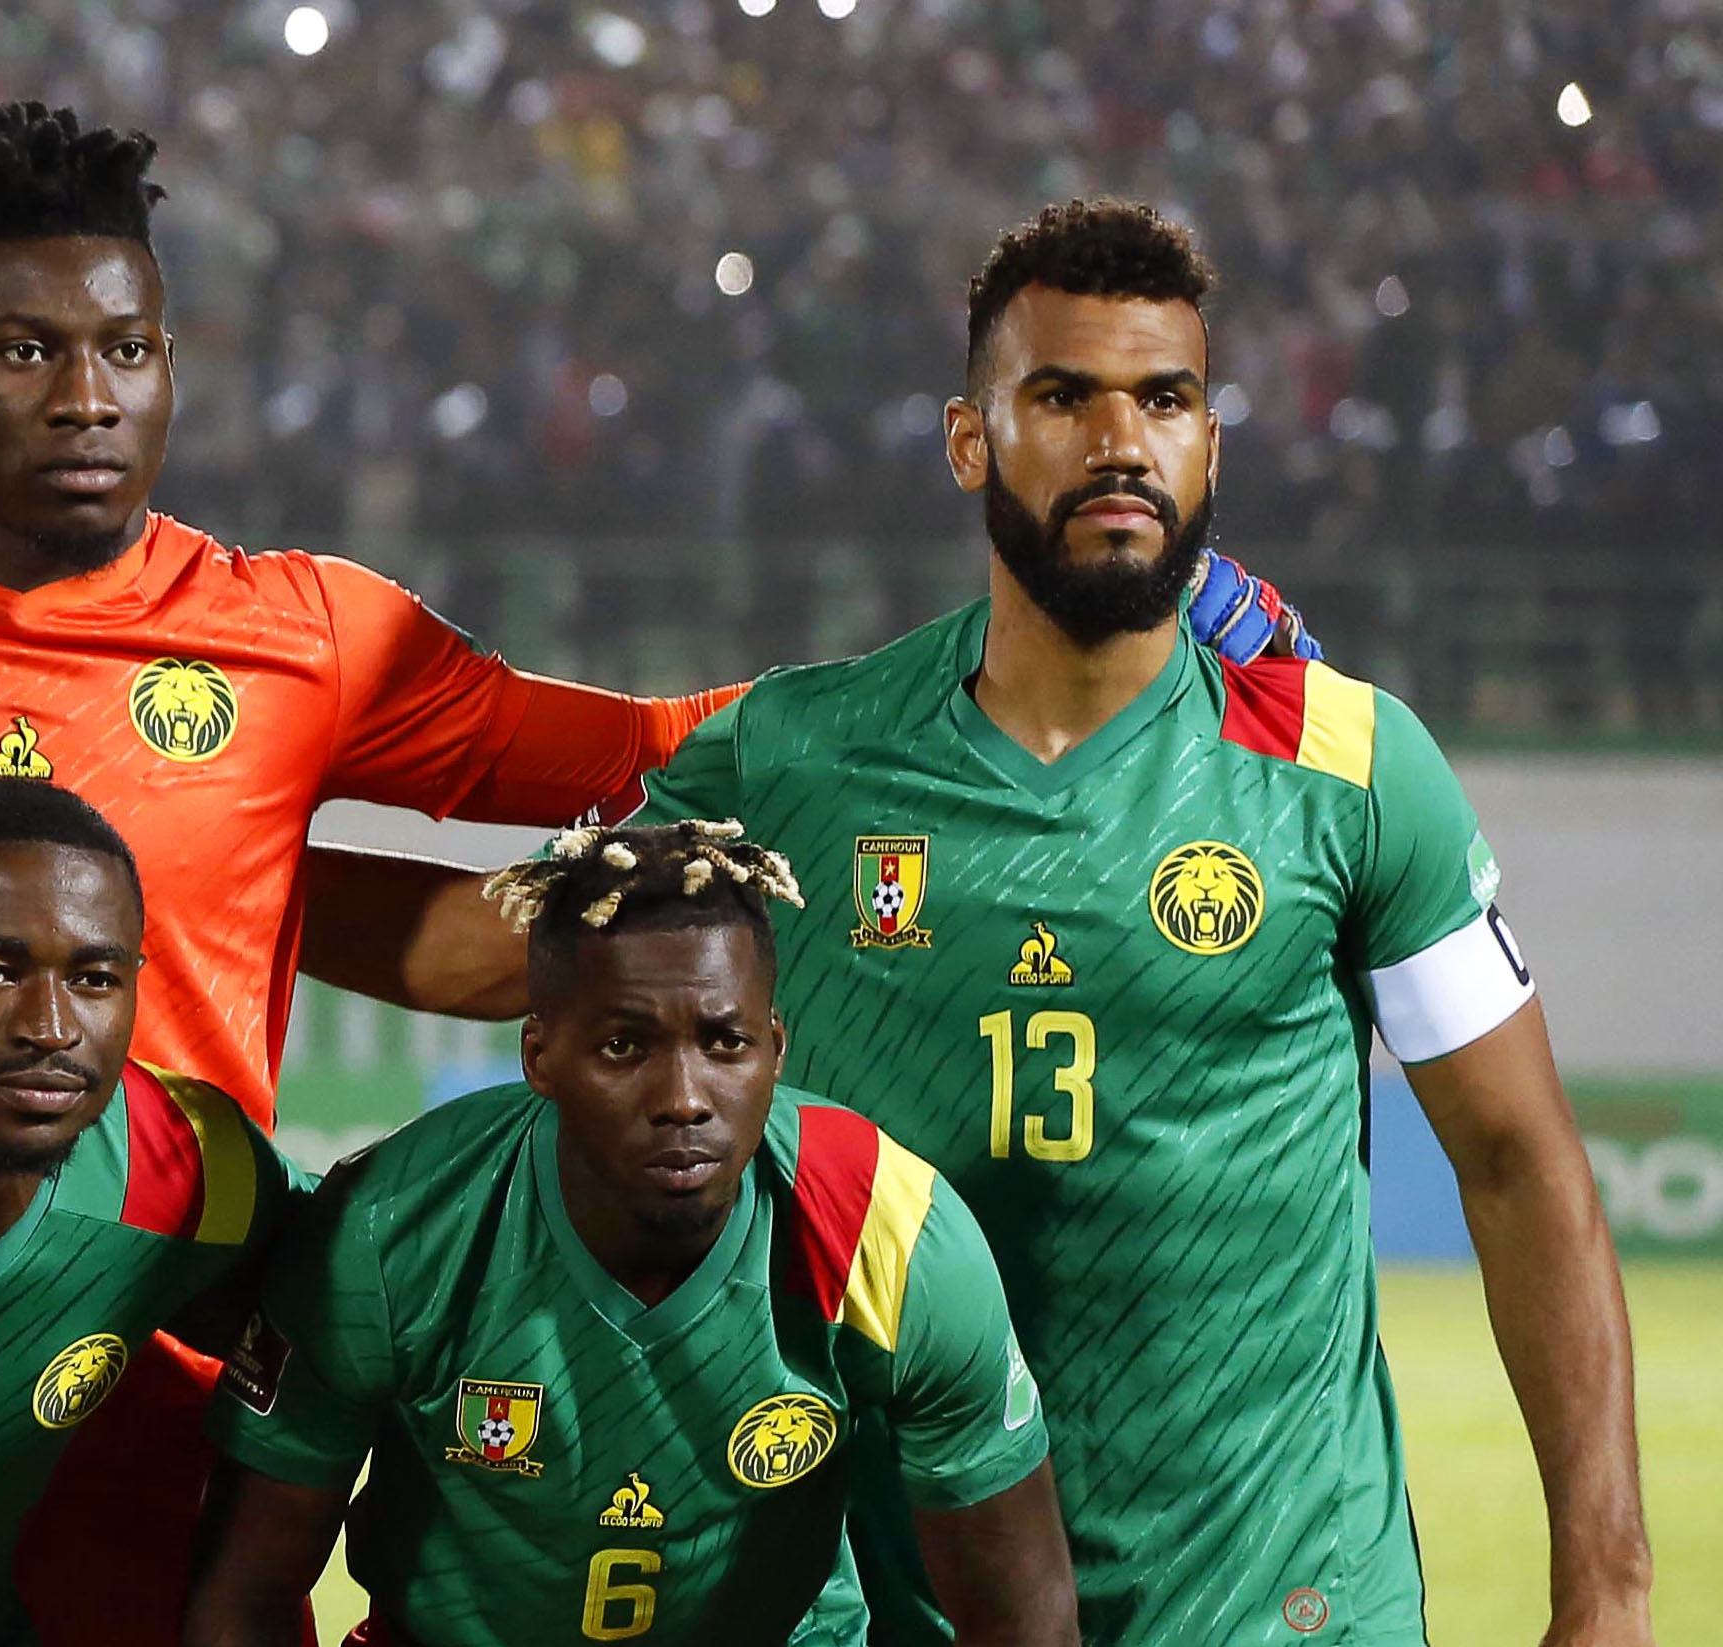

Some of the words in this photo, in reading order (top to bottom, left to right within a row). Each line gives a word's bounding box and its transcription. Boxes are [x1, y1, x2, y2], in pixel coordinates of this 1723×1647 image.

[862, 840, 921, 854] CAMEROUN
[979, 1010, 1098, 1162] 13
[466, 1384, 535, 1399] CAMEROUN
[581, 1549, 662, 1640] 6
